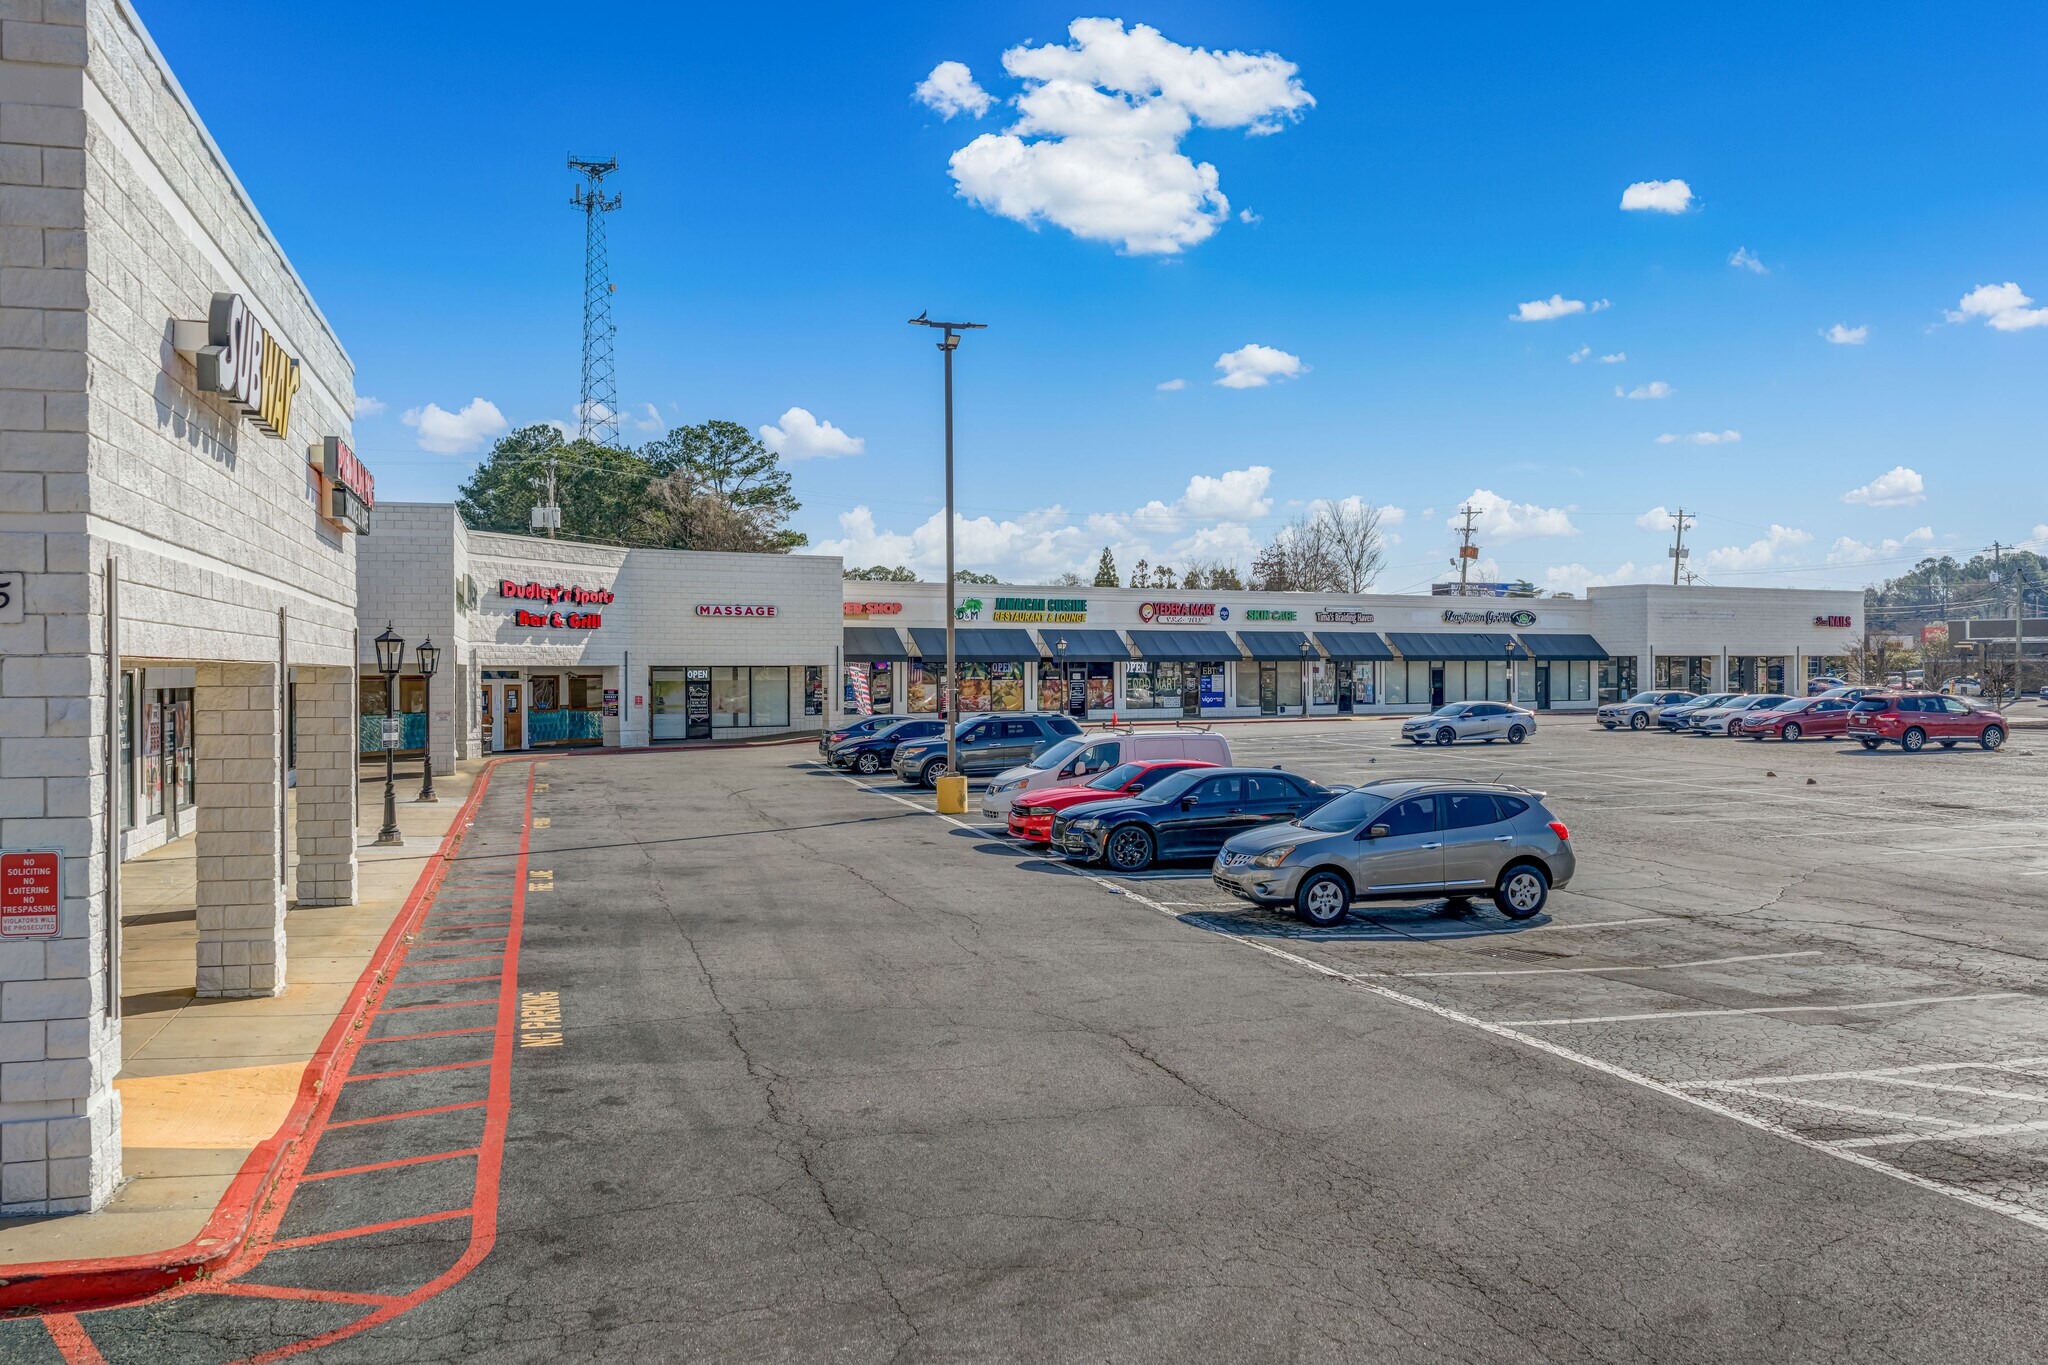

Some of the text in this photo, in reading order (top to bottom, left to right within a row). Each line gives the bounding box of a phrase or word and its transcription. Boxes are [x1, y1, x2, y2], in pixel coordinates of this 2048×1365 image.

[219, 294, 300, 440] SUBWAY
[500, 580, 614, 606] Dudley's Sports
[865, 602, 902, 614] SHOP
[995, 598, 1087, 611] JAMAICAN CUISINE
[1153, 603, 1216, 616] YEDERA MART
[700, 606, 775, 616] MASSAGE
[957, 610, 979, 620] D&M
[1247, 610, 1297, 621] SKIN CARE
[516, 609, 601, 629] Bar & Grill
[994, 611, 1086, 622] RESTAURANT & LOUNGE
[1358, 612, 1374, 622] Haven
[1828, 616, 1851, 627] NAILS
[992, 663, 1013, 672] OPEN
[1202, 666, 1216, 675] EBT
[687, 671, 708, 679] OPEN
[1154, 677, 1178, 690] MART
[1201, 696, 1214, 704] vigo
[23, 858, 35, 866] NO
[7, 868, 51, 876] SOLICITING
[23, 877, 35, 885] NO
[8, 887, 50, 895] LOITERING
[23, 896, 35, 904] NO
[2, 905, 57, 914] TRESPASSING
[520, 991, 563, 1048] NO PARKING
